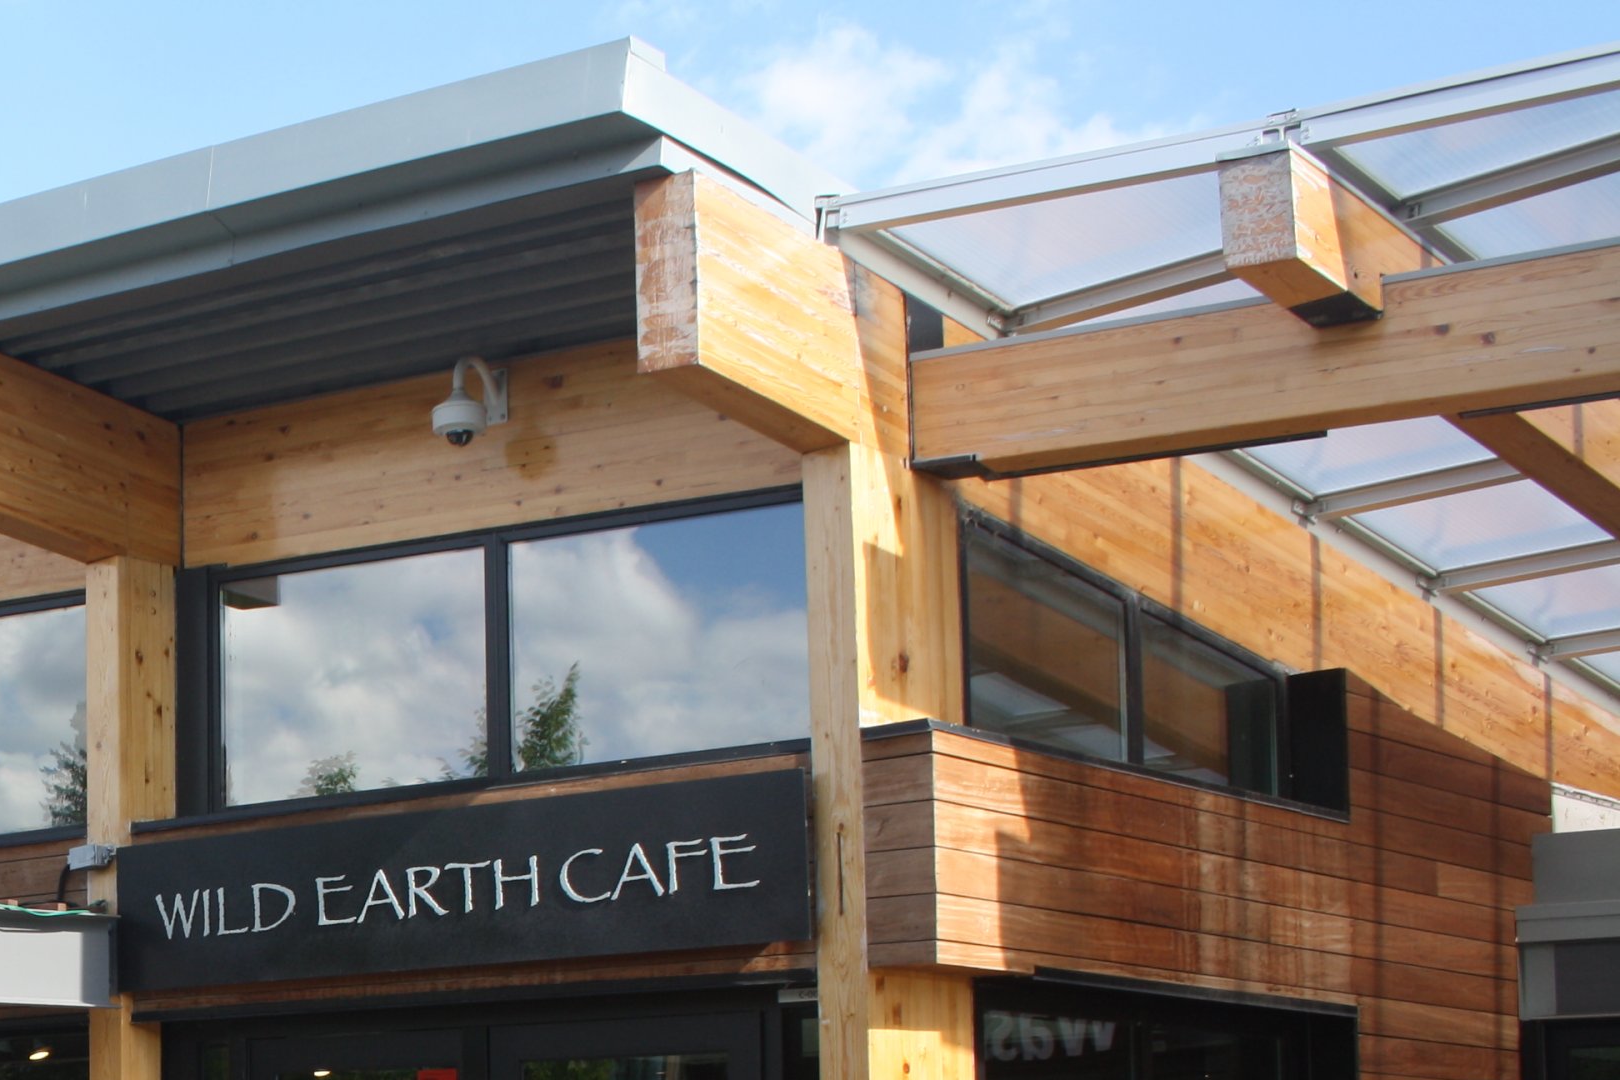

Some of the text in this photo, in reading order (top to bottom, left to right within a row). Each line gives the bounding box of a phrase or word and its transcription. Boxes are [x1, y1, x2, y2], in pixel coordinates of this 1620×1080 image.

[155, 833, 761, 941] WILD EARTH CAFE
